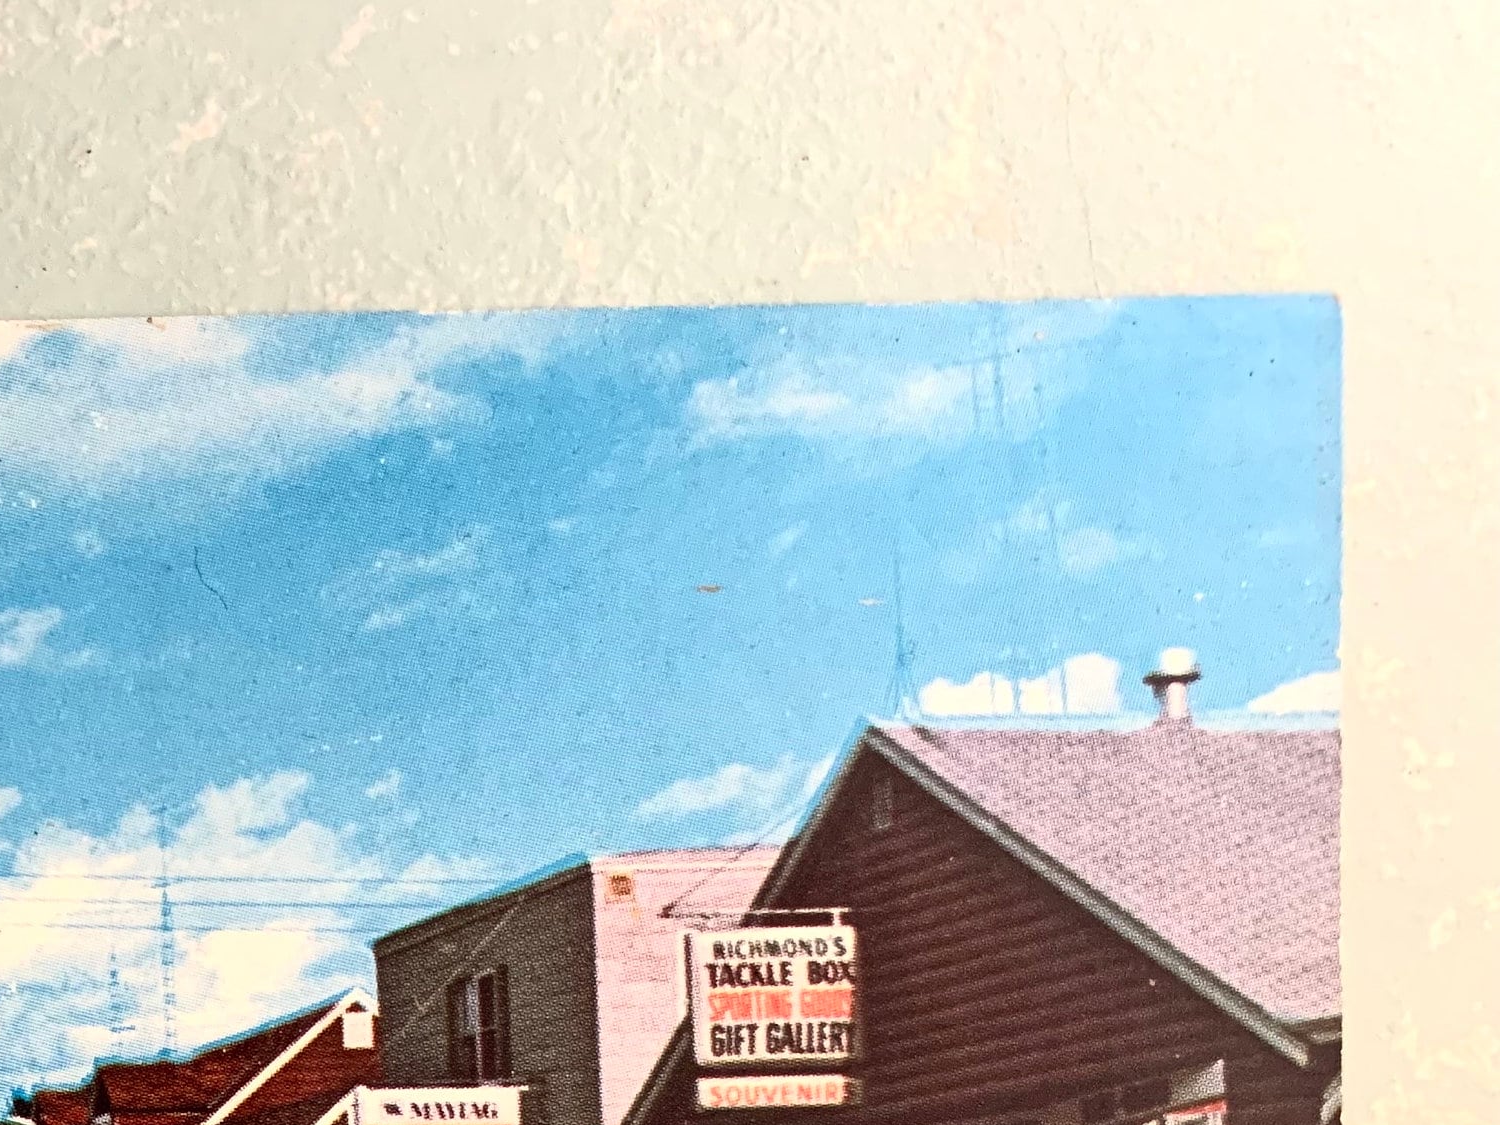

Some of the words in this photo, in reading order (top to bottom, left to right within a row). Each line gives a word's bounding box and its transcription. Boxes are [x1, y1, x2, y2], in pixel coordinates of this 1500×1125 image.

[712, 936, 847, 960] RICHMOND'S
[705, 961, 793, 988] TACKLE
[807, 960, 855, 985] BOX
[708, 990, 792, 1022] SPORTING
[801, 988, 855, 1019] GOODS
[710, 1023, 759, 1057] GIFT
[765, 1021, 855, 1055] GALLERY
[410, 1102, 499, 1120] MAYTAG
